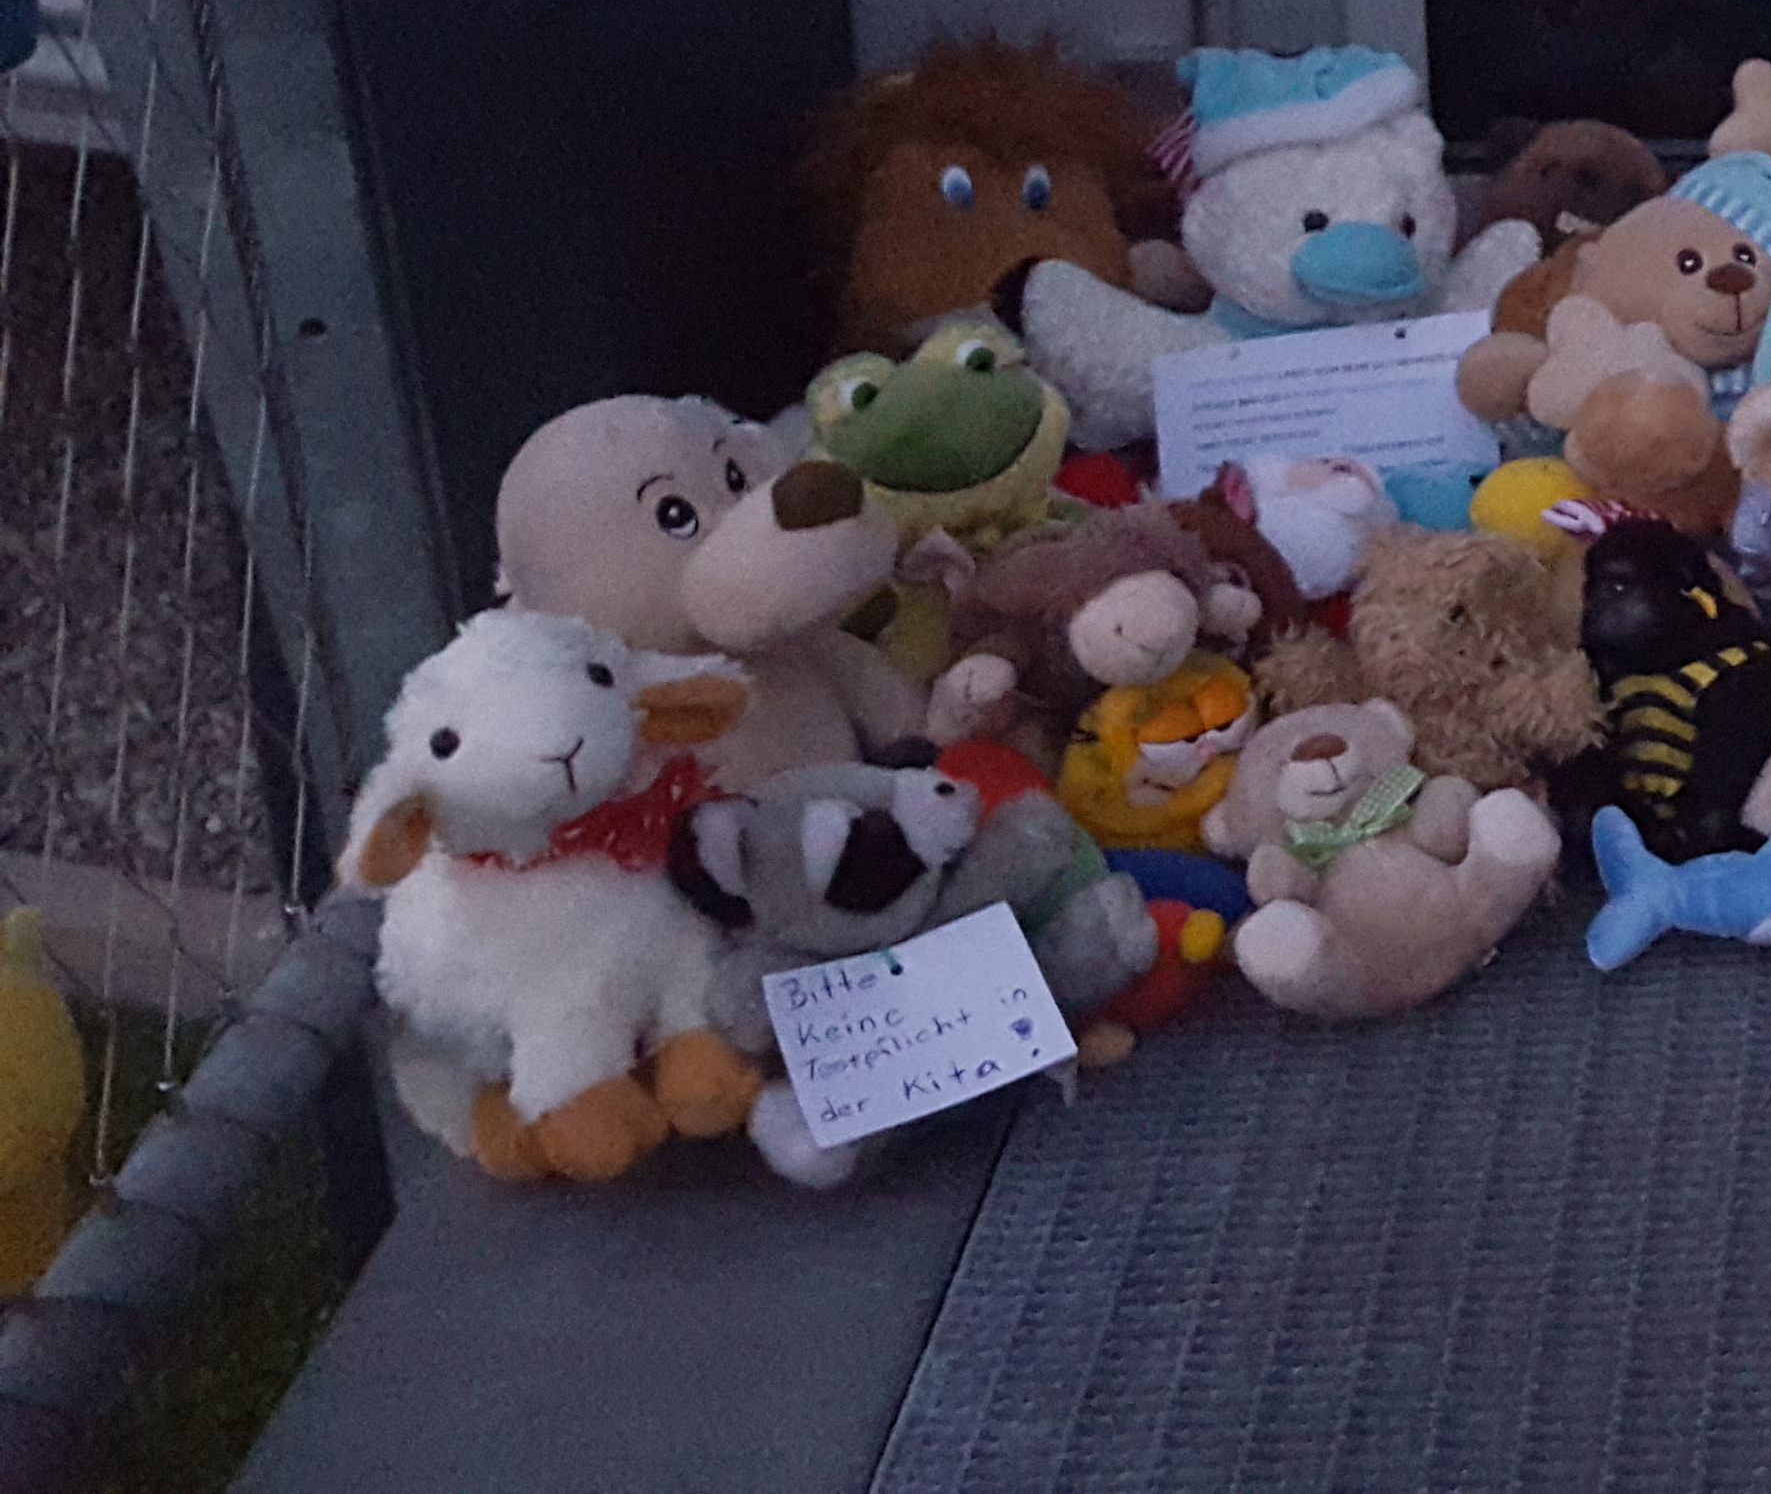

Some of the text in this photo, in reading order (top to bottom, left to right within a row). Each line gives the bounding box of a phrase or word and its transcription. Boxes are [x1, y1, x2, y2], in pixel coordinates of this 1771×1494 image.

[781, 969, 878, 1010] Bitte
[820, 1096, 872, 1124] der
[903, 1059, 1003, 1101] Kita
